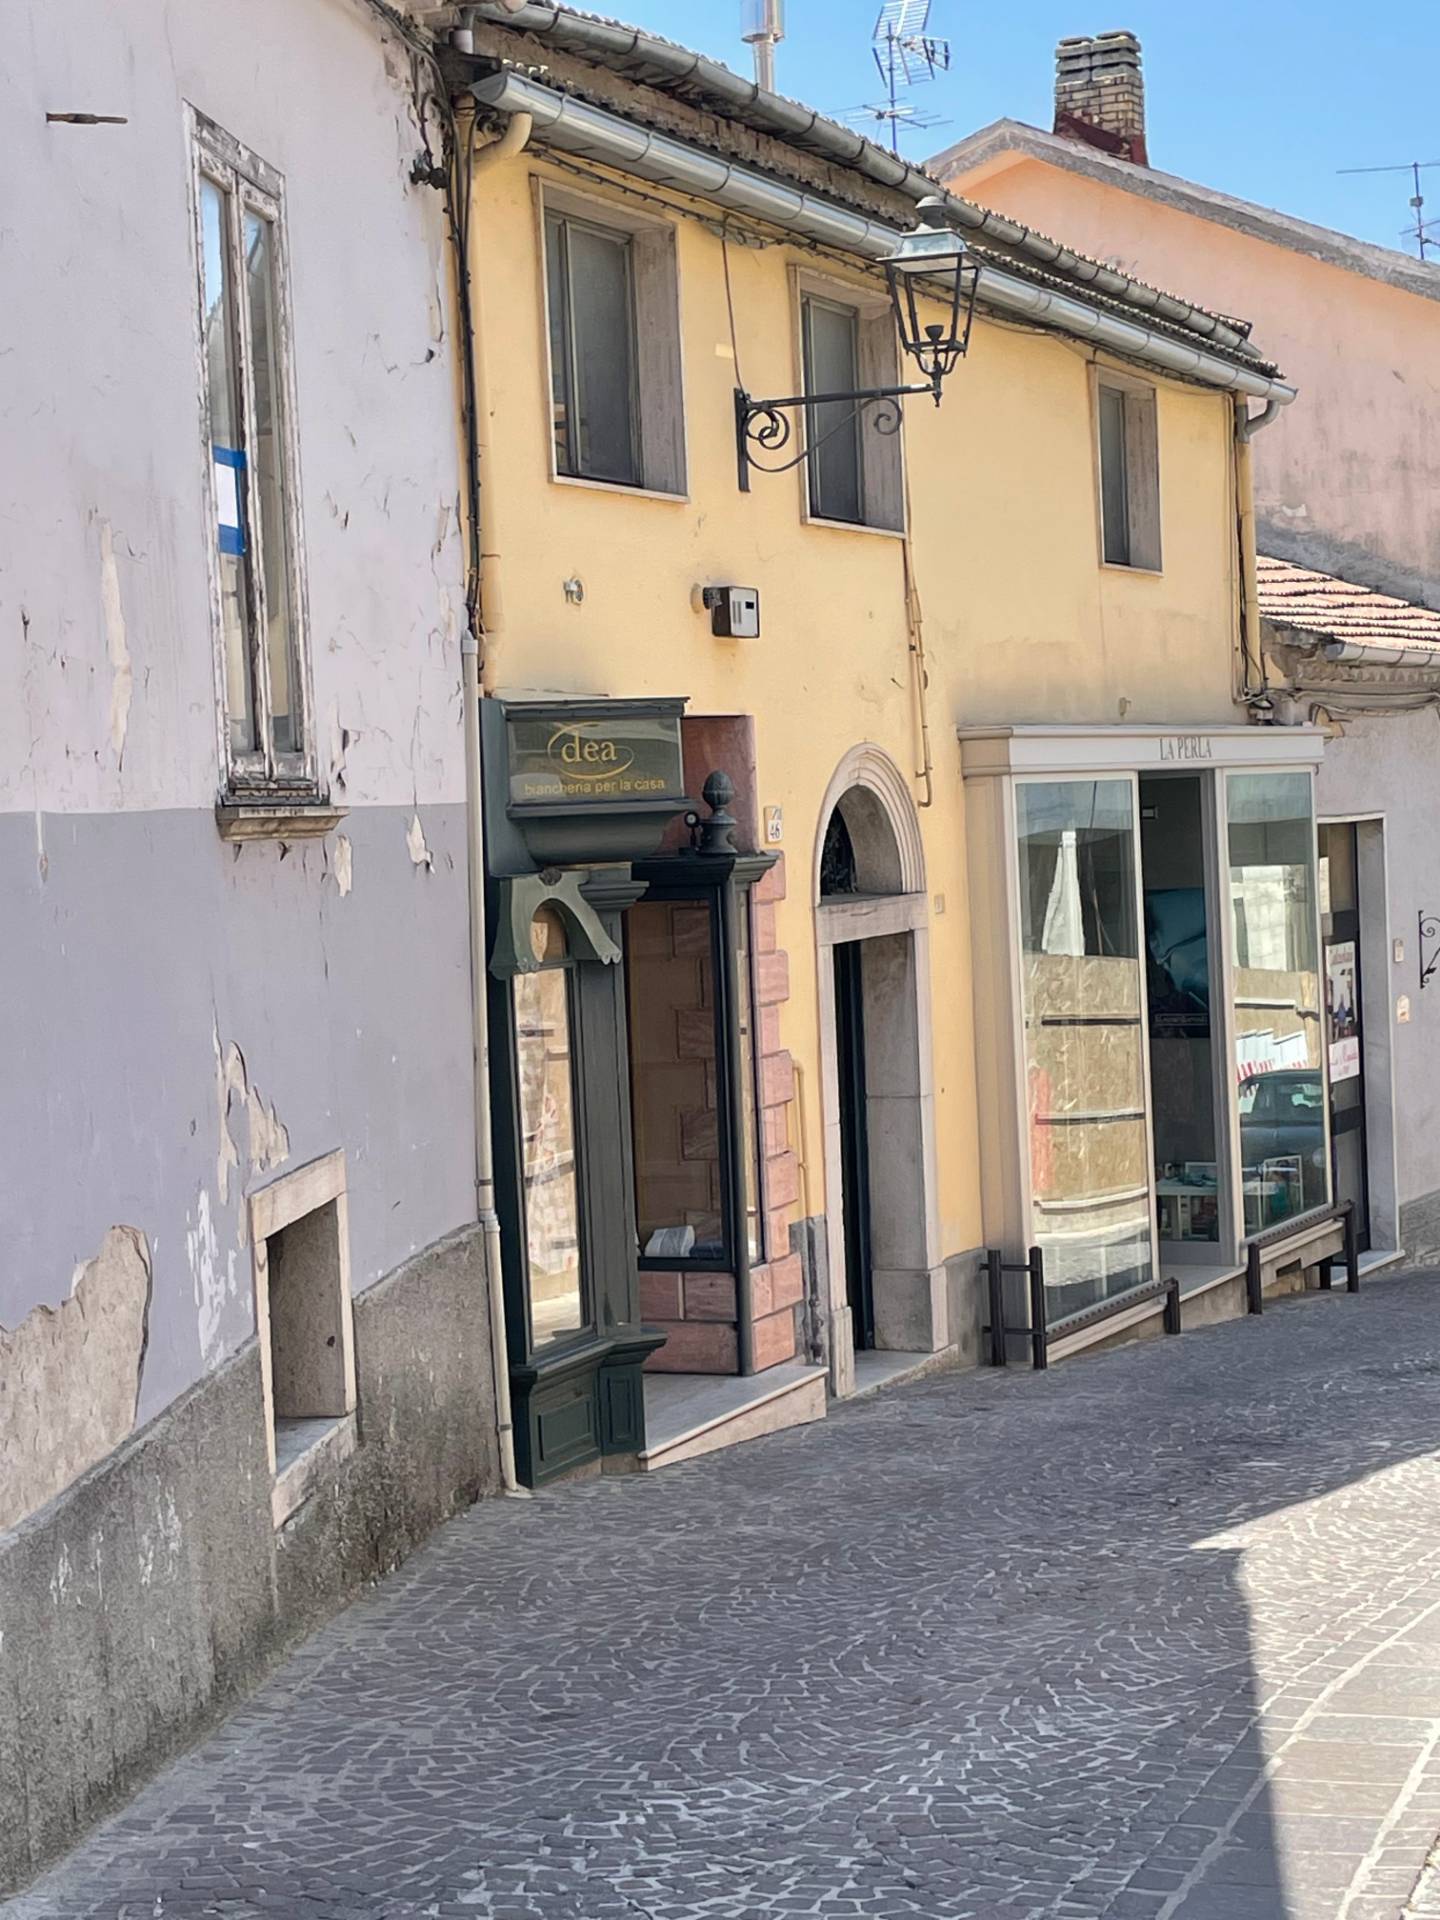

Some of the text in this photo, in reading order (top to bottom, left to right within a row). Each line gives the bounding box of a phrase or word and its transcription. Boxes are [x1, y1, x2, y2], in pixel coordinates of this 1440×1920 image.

[561, 729, 618, 763] dea
[1160, 735, 1212, 761] LA PERLA
[595, 780, 617, 795] per
[619, 778, 632, 792] la
[634, 778, 666, 791] casa
